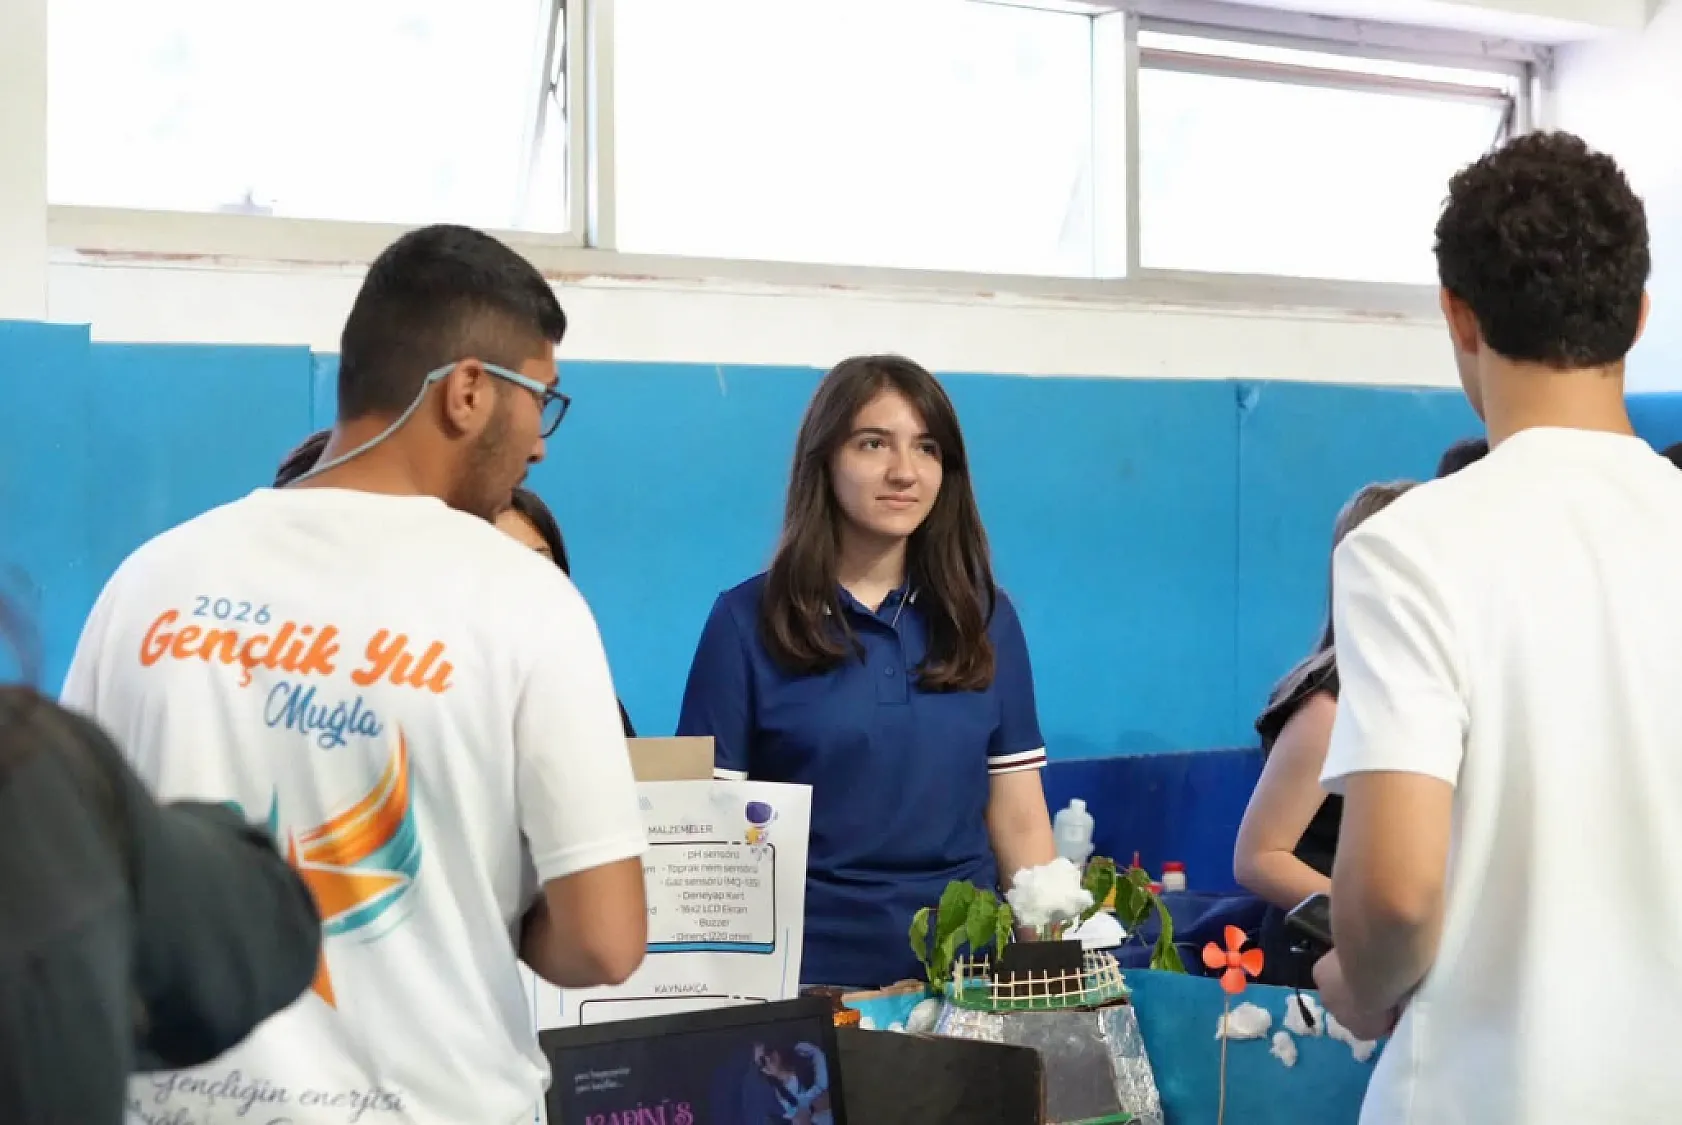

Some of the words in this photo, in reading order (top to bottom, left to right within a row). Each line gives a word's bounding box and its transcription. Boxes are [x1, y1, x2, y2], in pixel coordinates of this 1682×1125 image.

[193, 596, 271, 624] 2026
[139, 608, 341, 688] Gençlik
[350, 627, 454, 693] Yılı
[264, 680, 385, 750] Muğla
[648, 825, 714, 834] MALZEMELER
[699, 918, 730, 927] Buzzer
[654, 983, 709, 994] KAYNAKÇA
